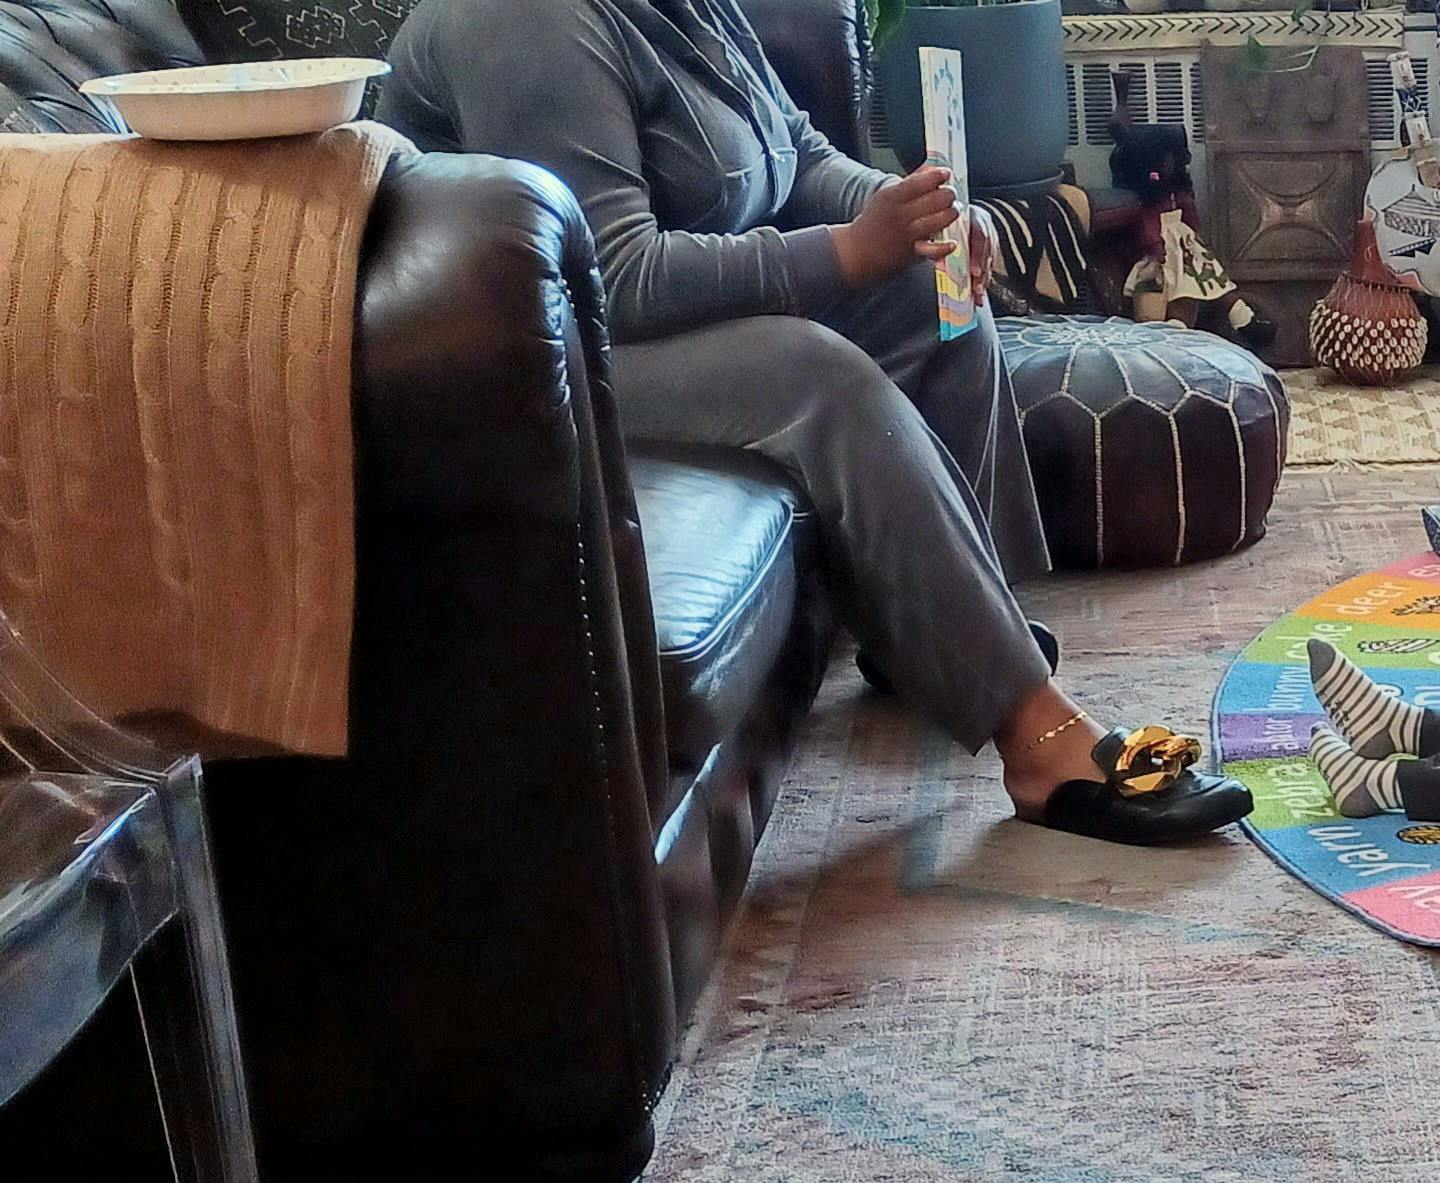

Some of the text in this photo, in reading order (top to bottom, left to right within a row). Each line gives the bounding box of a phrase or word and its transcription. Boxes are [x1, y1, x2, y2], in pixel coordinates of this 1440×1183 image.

[1326, 582, 1410, 615] deer
[1243, 666, 1309, 712] bunny
[1255, 763, 1335, 820] zebra
[1308, 824, 1431, 877] yarn
